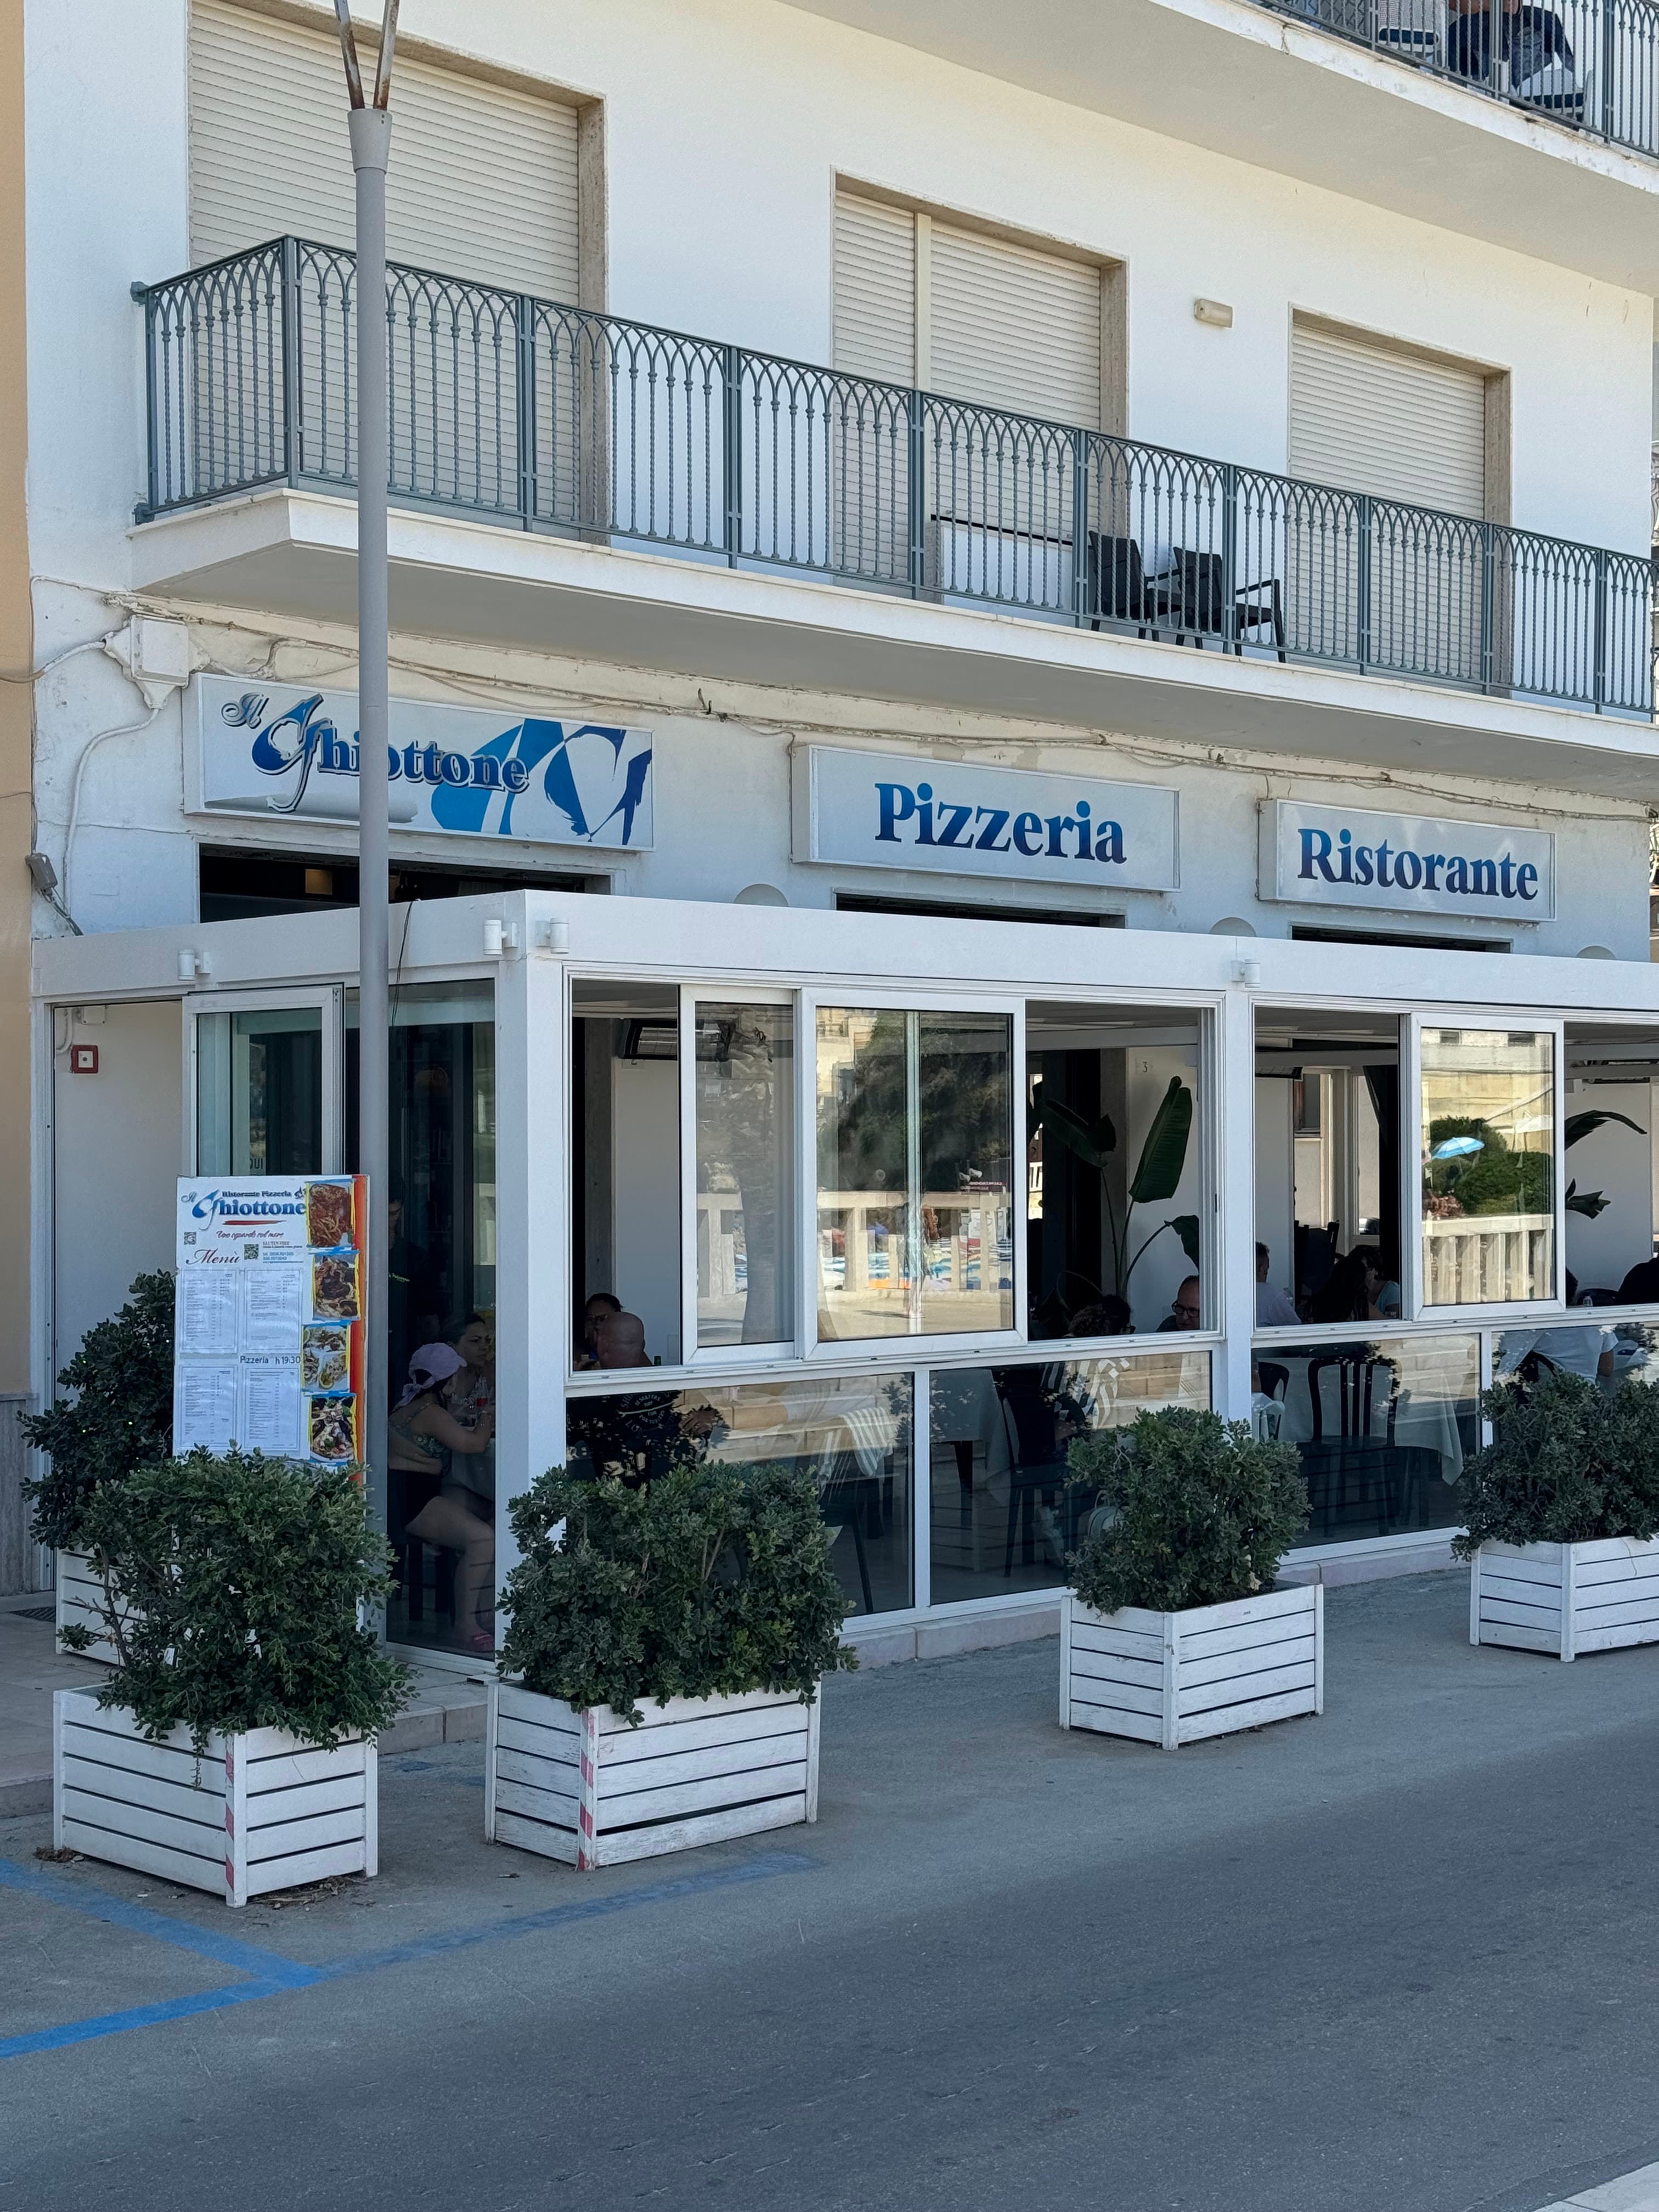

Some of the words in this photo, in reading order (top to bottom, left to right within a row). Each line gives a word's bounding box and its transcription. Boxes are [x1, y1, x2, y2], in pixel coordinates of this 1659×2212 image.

[221, 692, 269, 729] Il
[874, 782, 1127, 865] Pizzeria
[1297, 828, 1538, 901] Ristorante
[1142, 1061, 1148, 1073] 3
[181, 1192, 197, 1203] Il
[192, 1189, 306, 1231] Ghiottone
[185, 1248, 241, 1265] Menù
